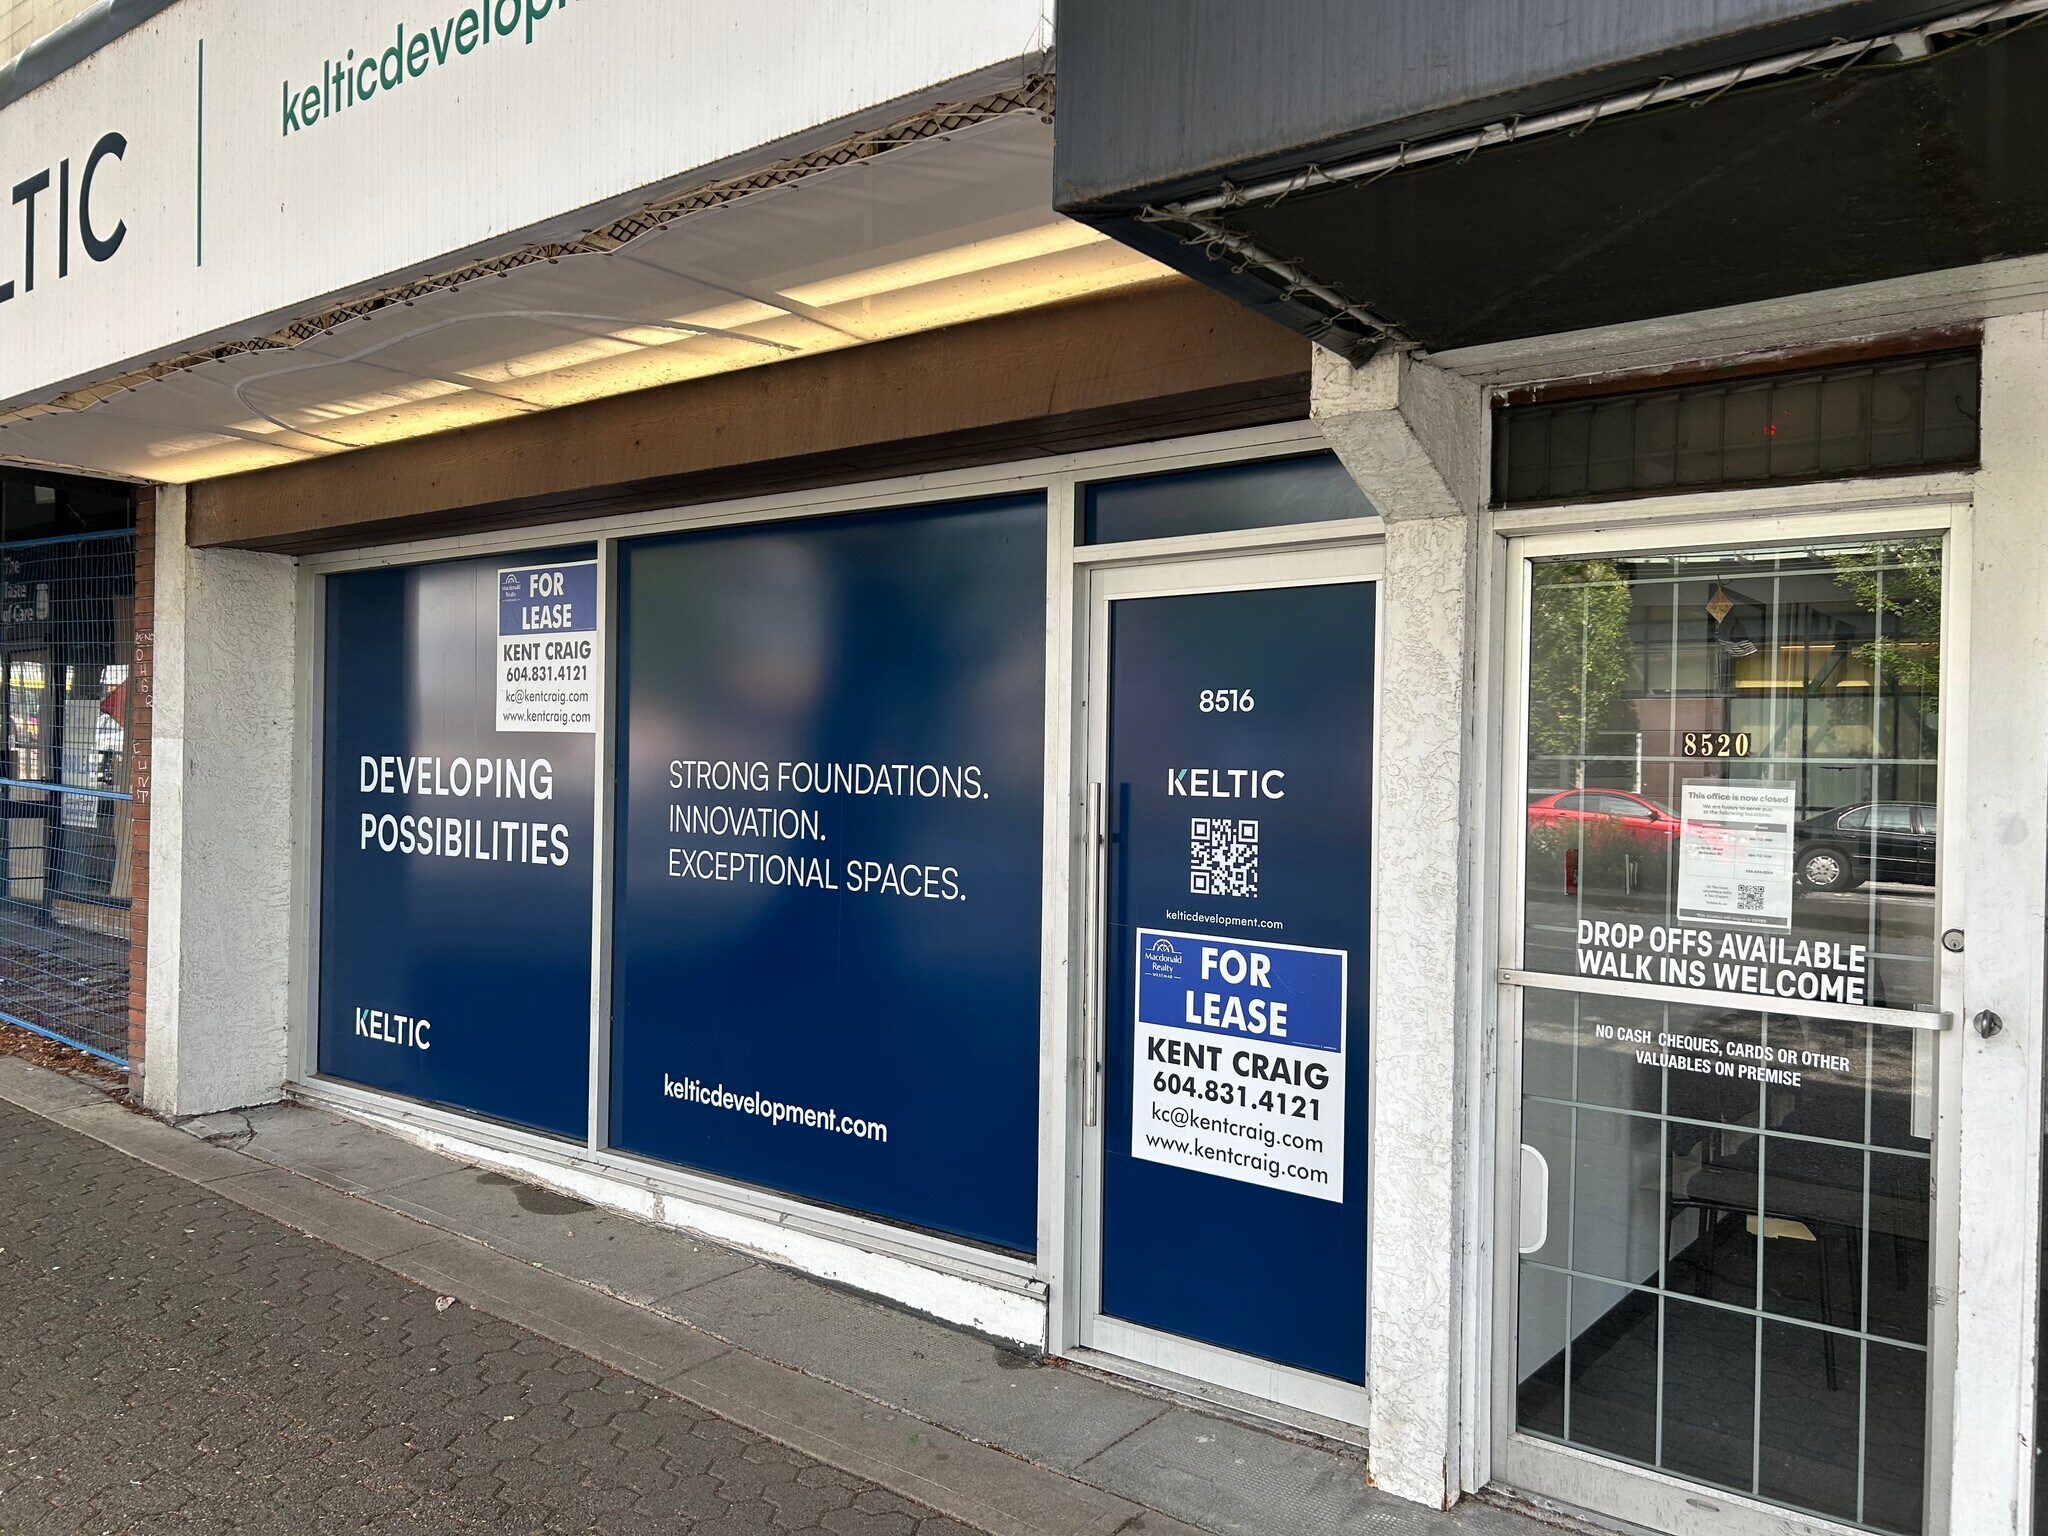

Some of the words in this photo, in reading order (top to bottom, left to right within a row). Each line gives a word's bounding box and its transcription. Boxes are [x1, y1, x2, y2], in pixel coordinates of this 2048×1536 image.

[281, 0, 567, 136] kelticdevelop
[0, 131, 128, 304] TIC
[529, 572, 564, 598] FOR
[522, 604, 572, 630] LEASE
[503, 643, 541, 662] KENT
[545, 640, 592, 661] CRAIG
[506, 665, 587, 682] 604.831.4121
[503, 709, 591, 725] www.kentcraig.com
[505, 689, 589, 706] kc@kentcraig.com
[1199, 688, 1255, 713] 8516
[1683, 733, 1750, 757] 8520
[360, 755, 554, 801] DEVELOPING
[669, 759, 769, 792] STRONG
[777, 761, 990, 800] FOUNDATIONS.
[1168, 768, 1285, 800] KELTIC
[1707, 793, 1731, 801] office
[360, 813, 570, 867] POSSIBILITIES
[669, 804, 827, 842] INNOVATION.
[669, 848, 839, 890] EXCEPTIONAL
[847, 860, 967, 902] SPACES.
[1166, 909, 1284, 931] kelticdevelopment.com
[1145, 952, 1183, 964] Macdonald
[1201, 946, 1272, 989] FOR
[1577, 919, 1645, 952] DROP
[1650, 926, 1714, 958] OFFS
[1719, 932, 1867, 974] AVAILABLE
[1152, 962, 1174, 974] Realty
[1578, 948, 1654, 982] WALK
[1659, 957, 1706, 989] INS
[1713, 962, 1866, 1006] WELCOME
[355, 1006, 432, 1051] KELTIC
[1185, 990, 1288, 1038] LEASE
[1148, 1036, 1223, 1073] KENT
[1232, 1050, 1330, 1091] CRAIG
[1595, 1024, 1614, 1041] NO
[1617, 1027, 1652, 1046] CASH
[1658, 1032, 1724, 1057] CHEQUES,
[1726, 1041, 1774, 1062] CARDS
[1778, 1048, 1798, 1065] OR
[1801, 1050, 1851, 1073] OTHER
[1635, 1049, 1712, 1075] VALUABLES
[1715, 1059, 1735, 1077] ON
[1738, 1064, 1802, 1088] PREMISE
[664, 1072, 888, 1143] kelticdevelopment.com
[1153, 1071, 1320, 1121] 604.831.4121
[1152, 1102, 1323, 1153] kc@kentcraig.com
[1146, 1133, 1329, 1185] www.kentcraig.com
